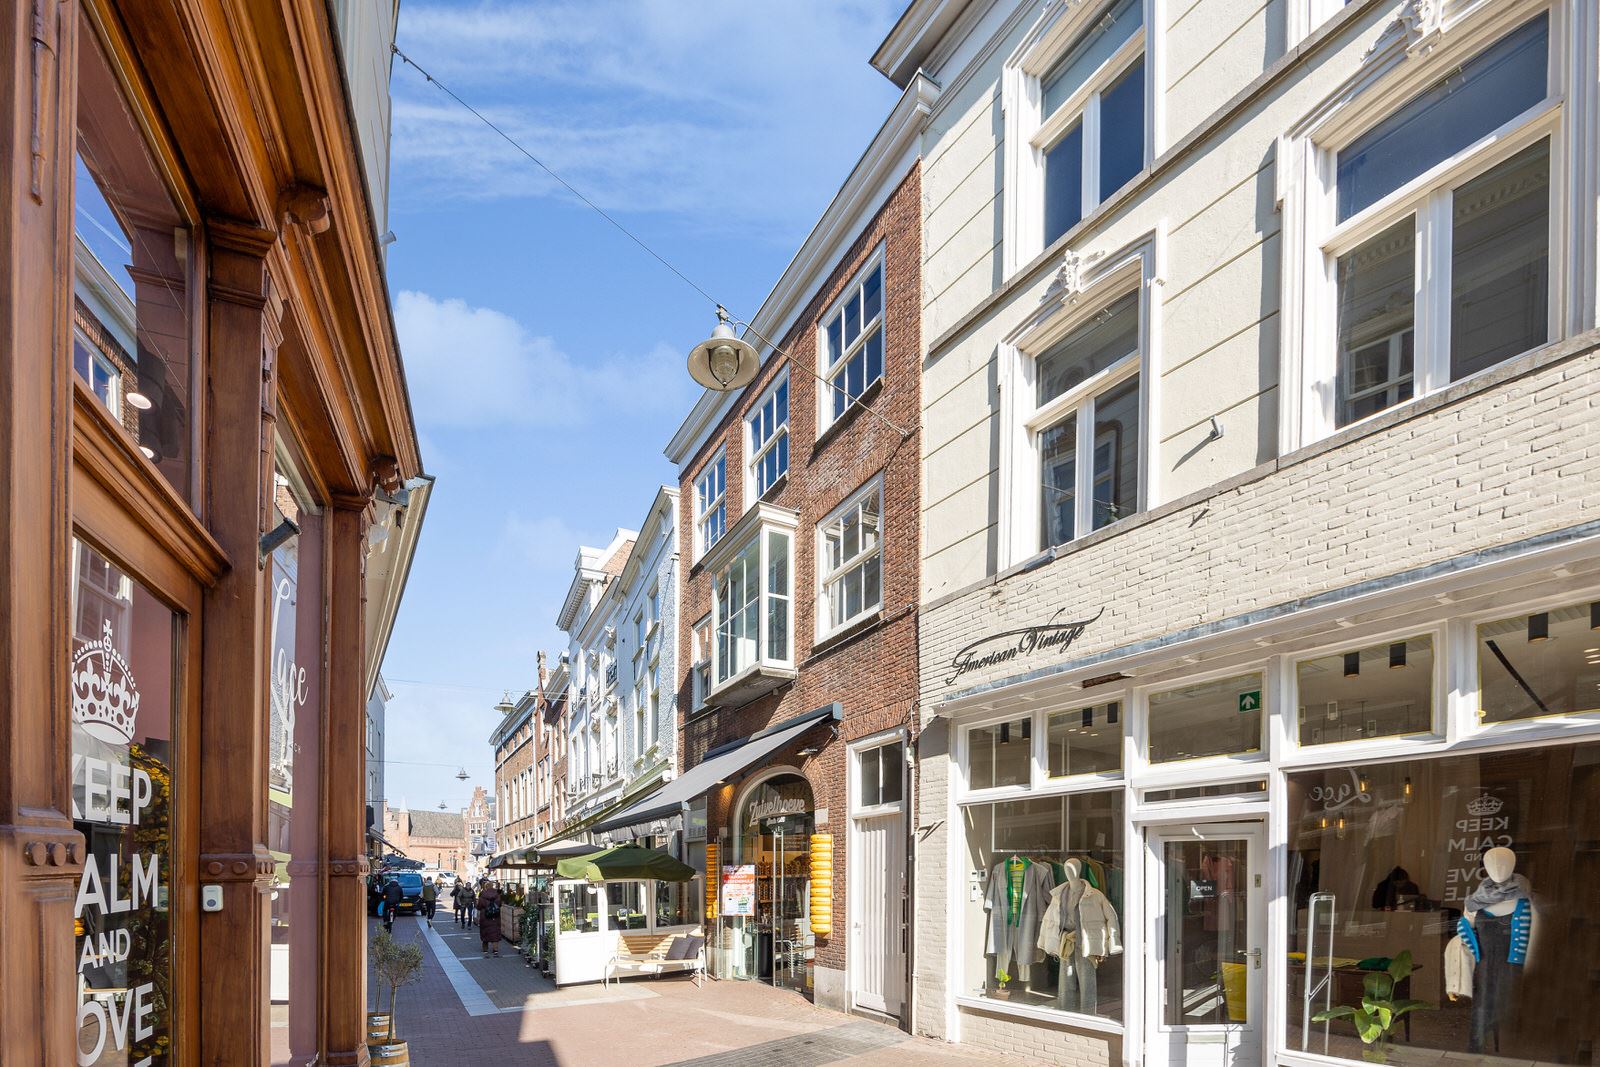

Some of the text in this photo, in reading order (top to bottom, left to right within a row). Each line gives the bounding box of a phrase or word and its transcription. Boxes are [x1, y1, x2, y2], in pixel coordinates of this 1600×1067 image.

[945, 608, 1092, 686] American Vintage
[749, 795, 806, 827] Zuivelhoeve
[74, 853, 158, 918] ALM
[78, 928, 131, 973] AND
